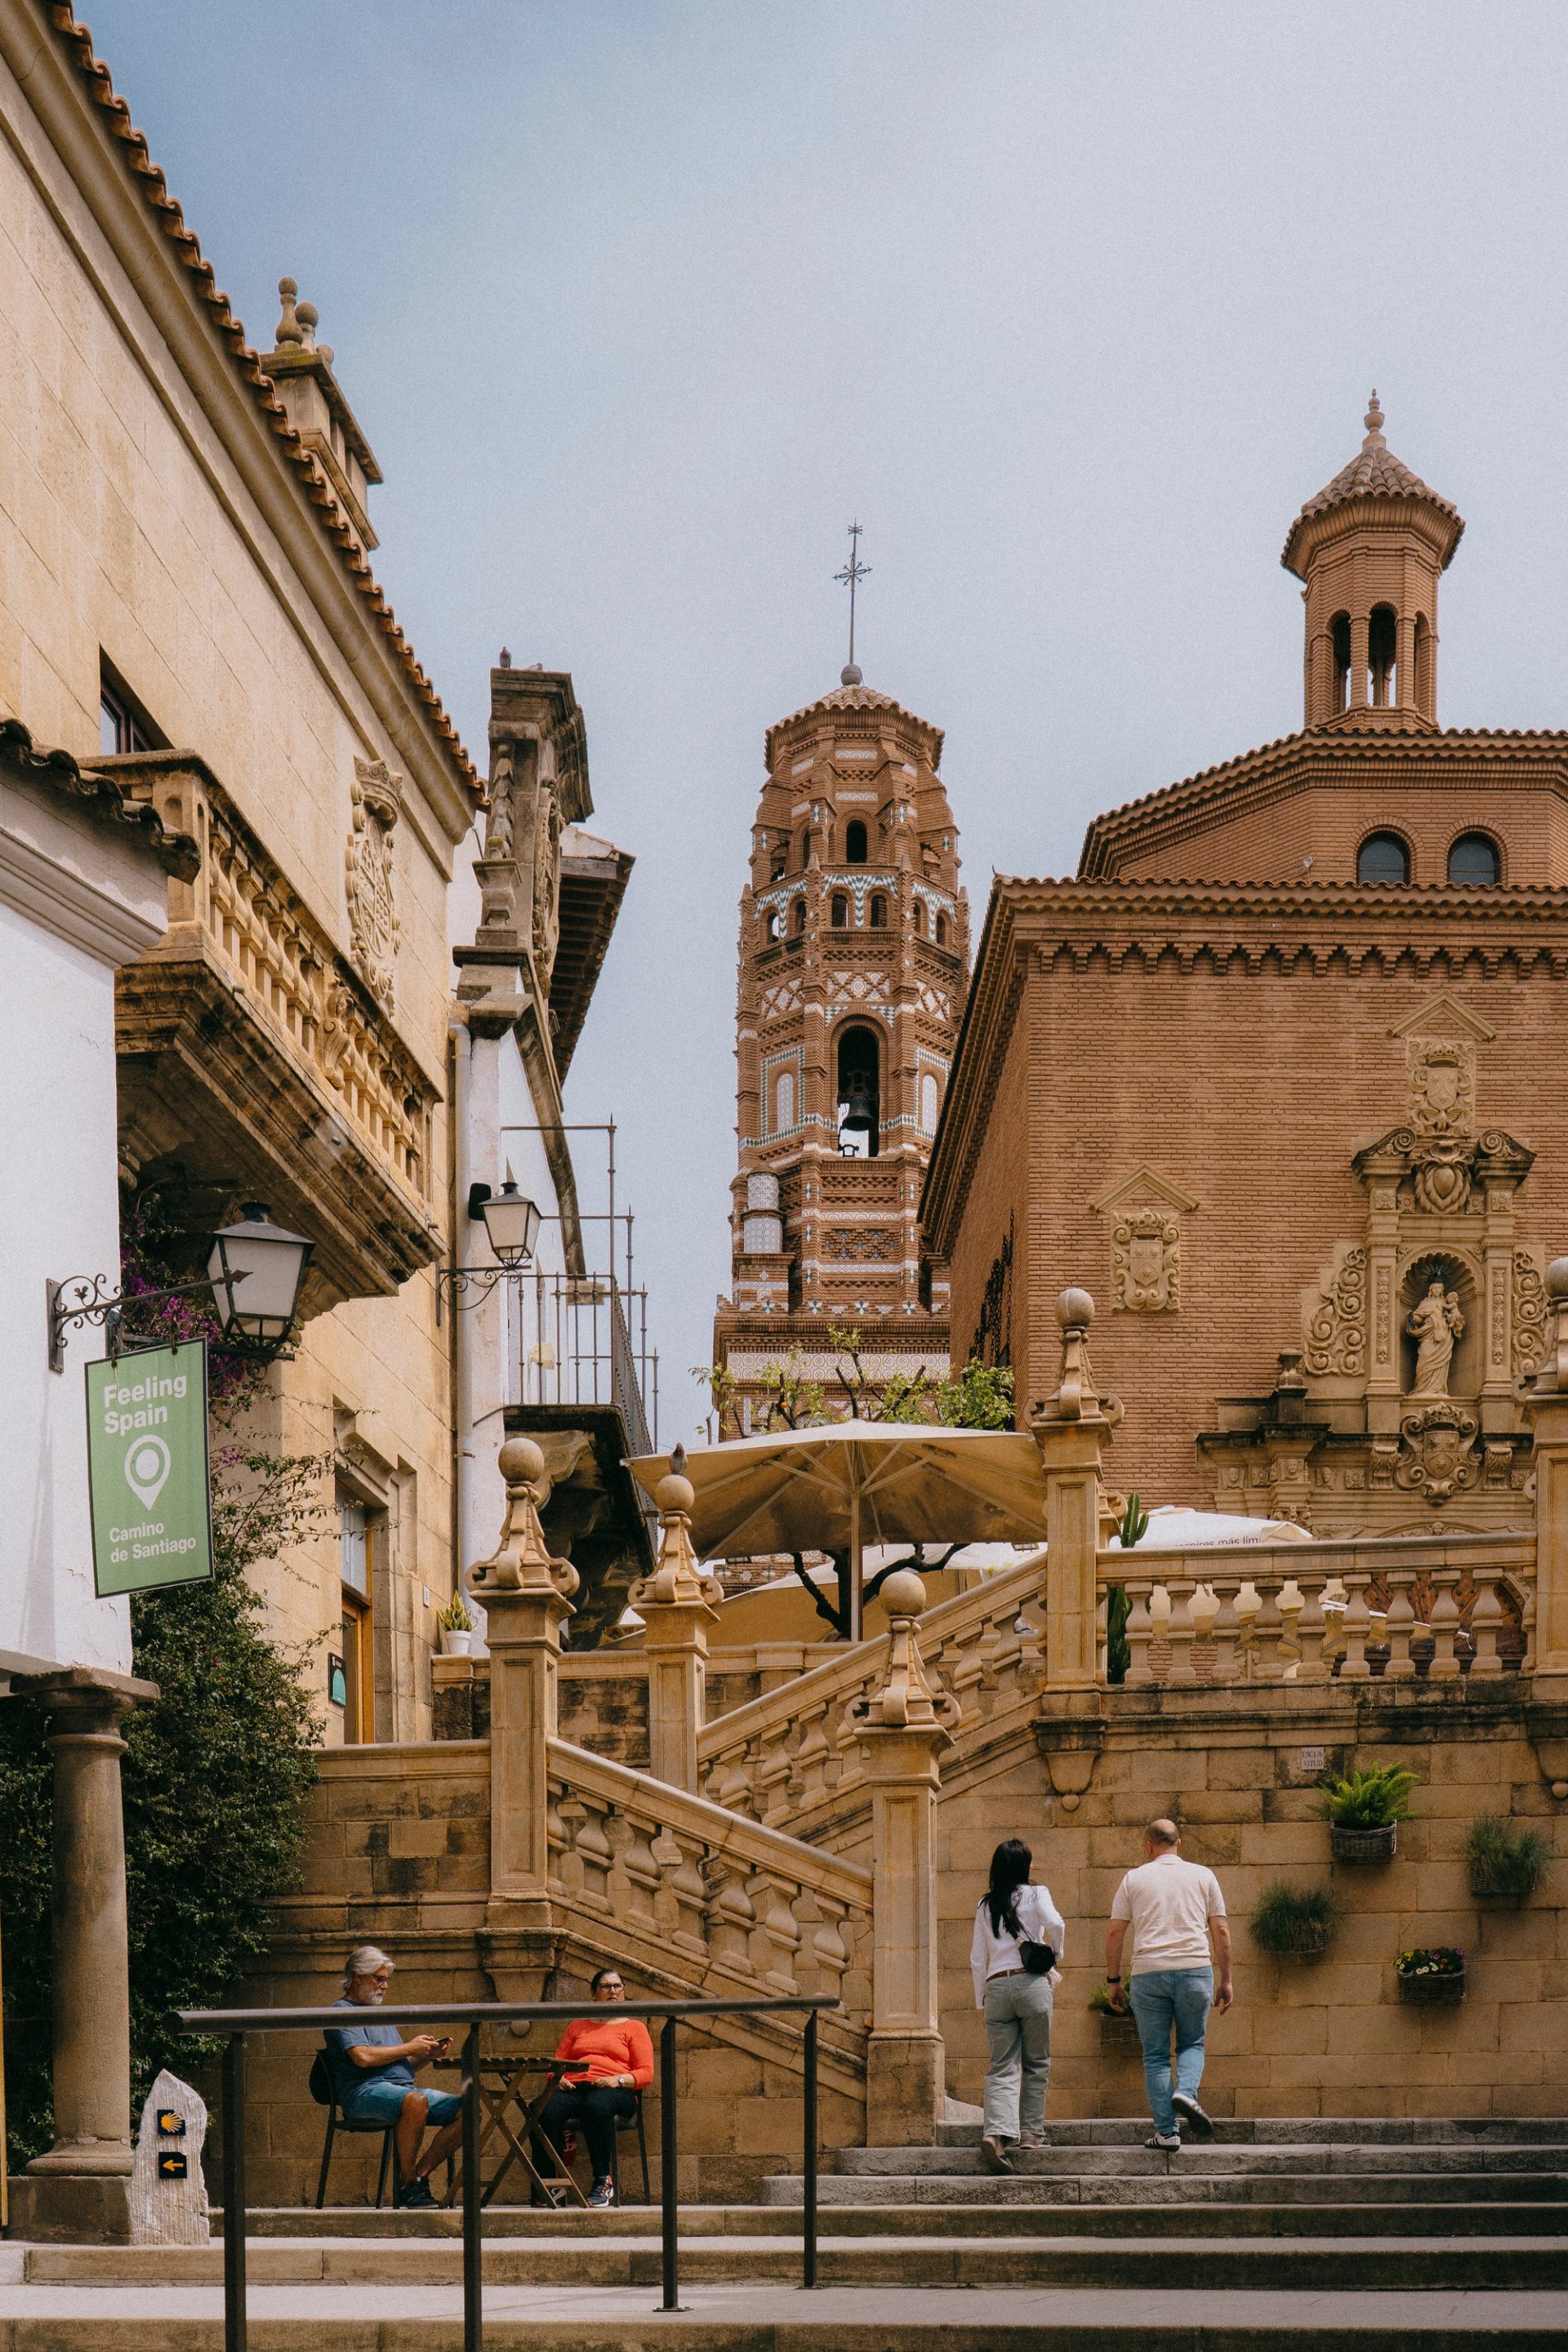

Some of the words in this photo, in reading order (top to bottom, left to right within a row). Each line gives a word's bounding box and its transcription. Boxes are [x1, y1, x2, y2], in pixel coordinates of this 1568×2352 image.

[104, 1375, 187, 1408] Feeling
[105, 1403, 168, 1437] Spain
[109, 1522, 164, 1543] Camino
[1218, 1537, 1240, 1545] más
[1242, 1535, 1261, 1544] lim
[110, 1547, 128, 1563] de
[132, 1537, 196, 1559] Santiago
